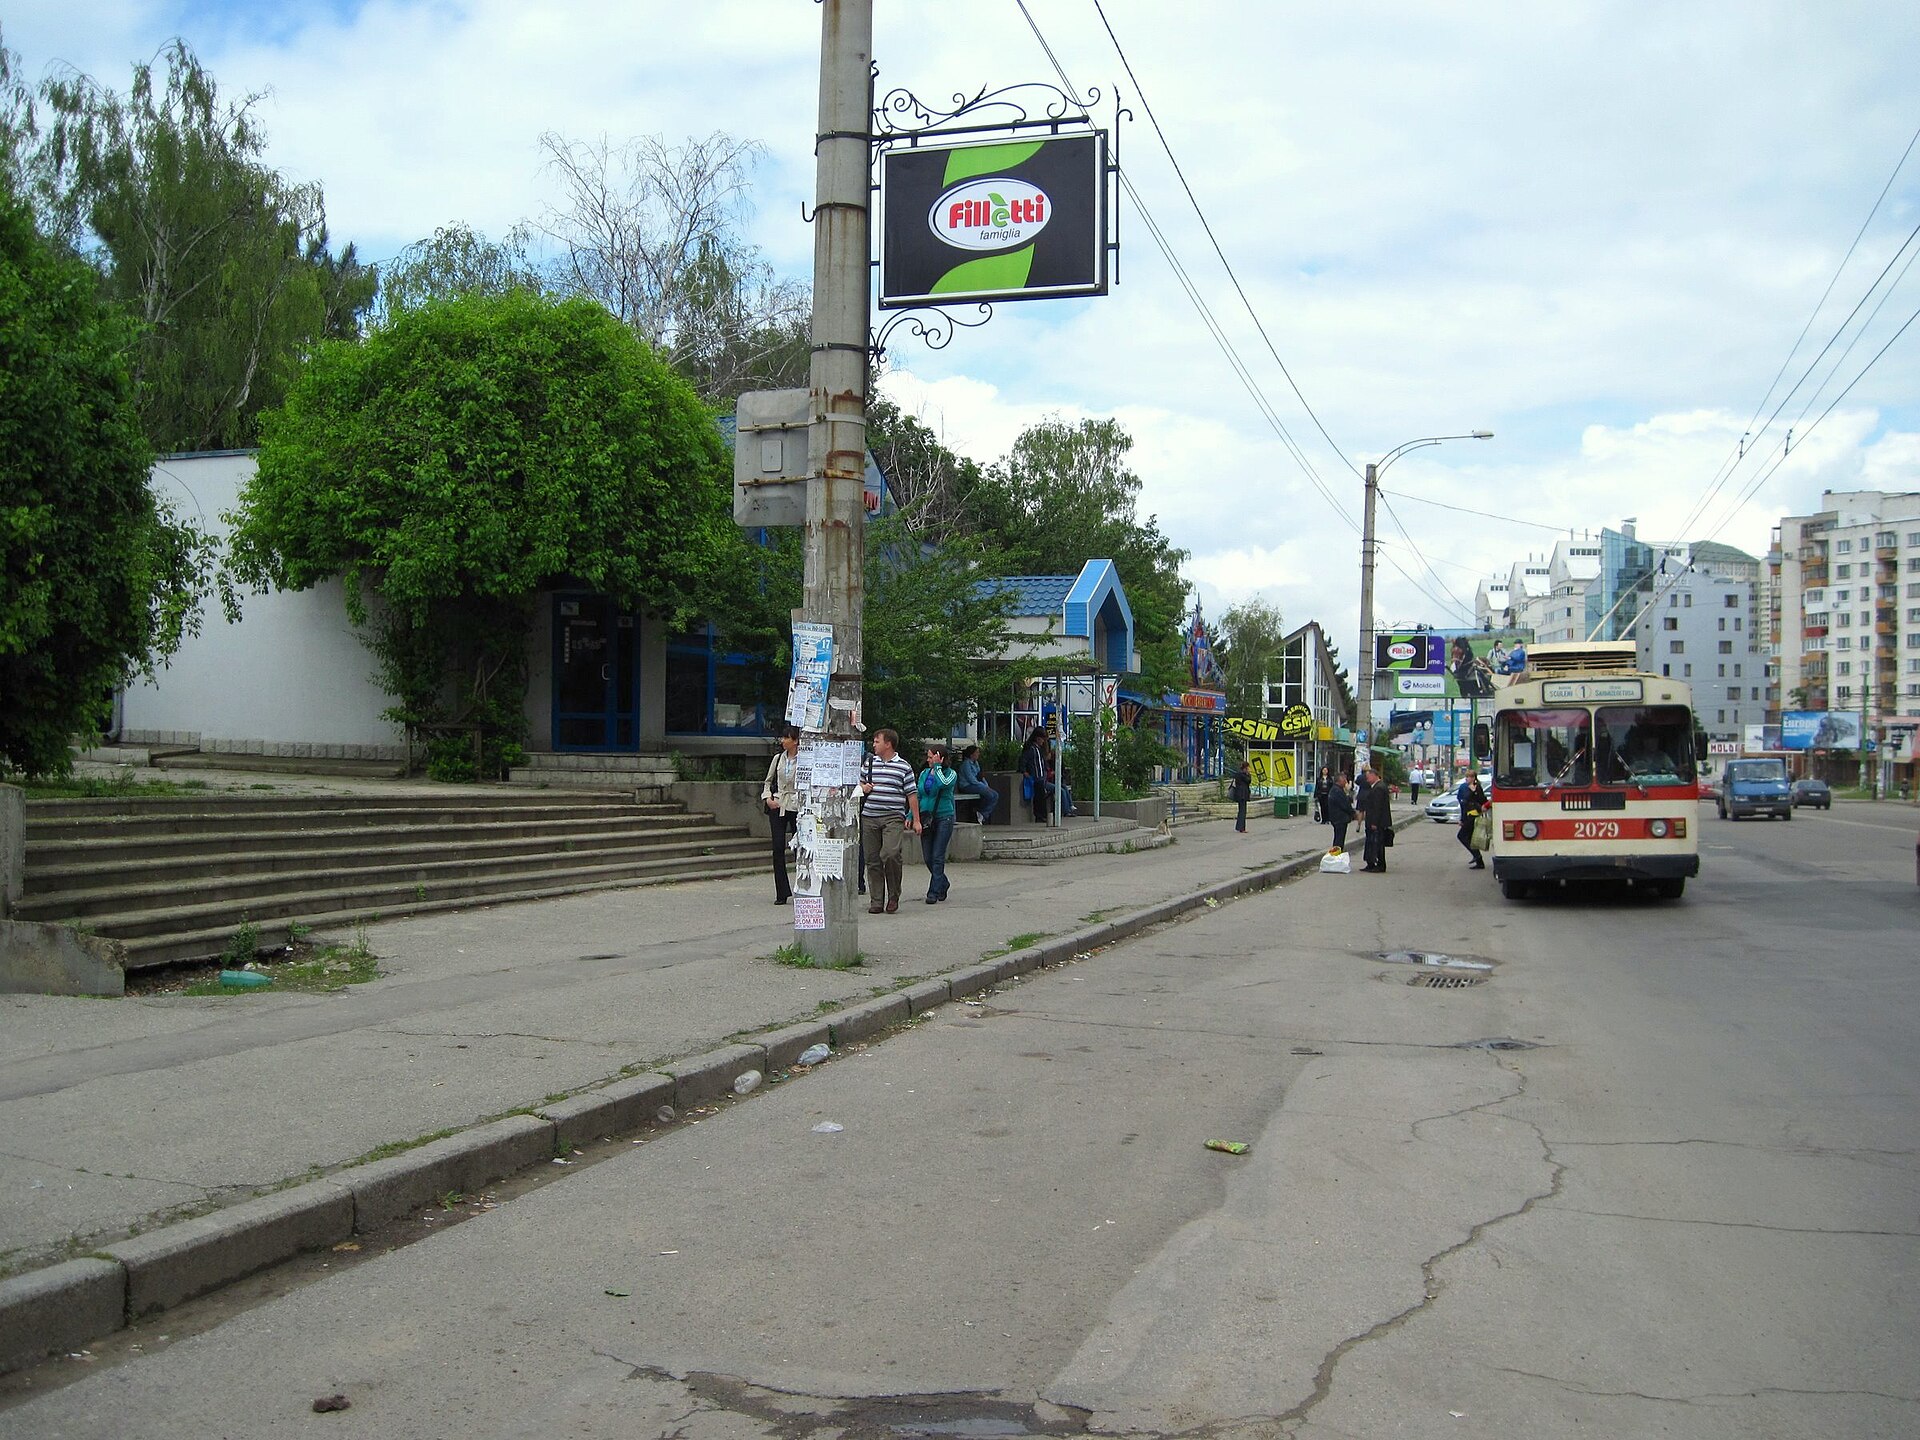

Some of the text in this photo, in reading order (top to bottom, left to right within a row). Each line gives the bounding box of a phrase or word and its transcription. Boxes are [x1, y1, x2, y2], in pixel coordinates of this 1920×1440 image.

[979, 229, 1021, 241] famiglia
[1580, 686, 1586, 698] 1
[1227, 717, 1279, 740] GSM
[1282, 715, 1311, 730] GSM
[1574, 821, 1619, 838] 2079
